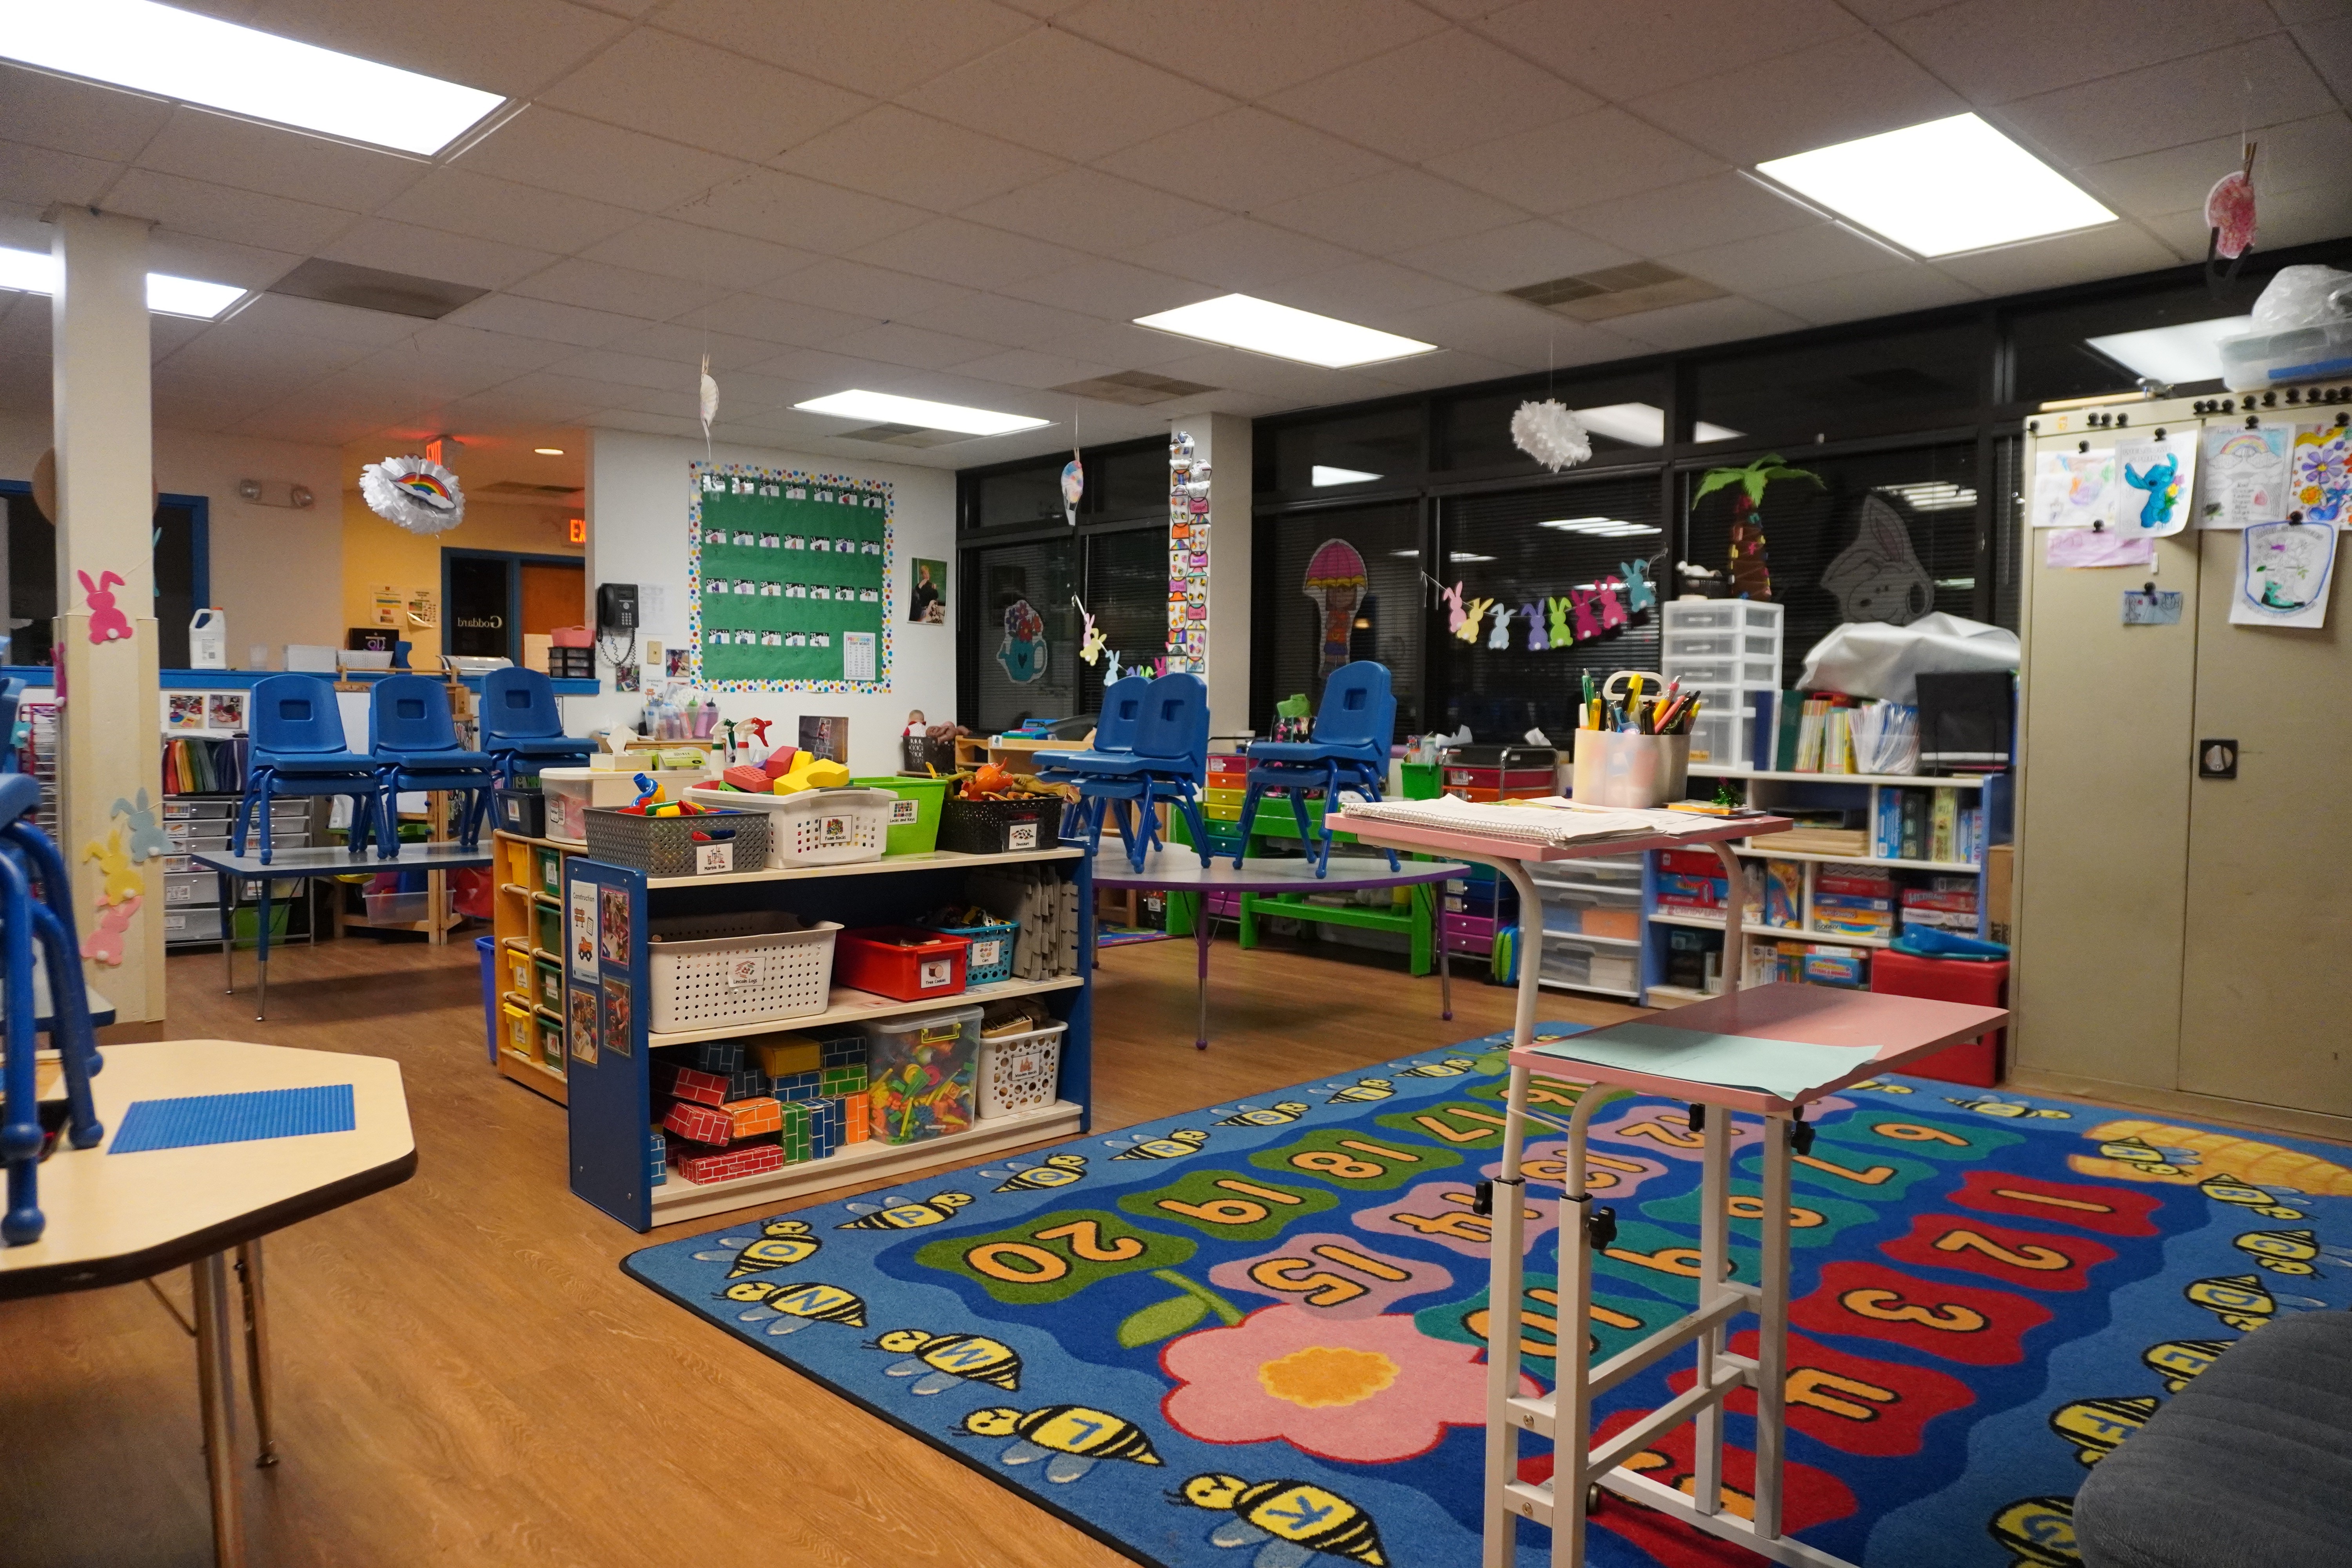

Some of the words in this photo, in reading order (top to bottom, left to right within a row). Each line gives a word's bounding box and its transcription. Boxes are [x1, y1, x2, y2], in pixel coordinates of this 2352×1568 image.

[573, 892, 595, 902] Construction
[1251, 1113, 1282, 1122] S
[1412, 1107, 1508, 1142] 17
[1151, 1143, 1186, 1153] R
[1288, 1140, 1423, 1178] 18
[1028, 1170, 1066, 1181] Q
[1155, 1180, 1307, 1225] 19
[1991, 1189, 2116, 1213] 1
[890, 1210, 925, 1224] P
[759, 1243, 797, 1258] O
[964, 1220, 1148, 1284] 20
[1931, 1229, 2074, 1270] 2
[2253, 1239, 2299, 1252] C
[1248, 1244, 1412, 1308] 15
[784, 1290, 841, 1312] N
[2205, 1289, 2258, 1306] D
[1837, 1288, 1990, 1332] 3
[2164, 1351, 2209, 1368] E
[1265, 1495, 1334, 1532] K
